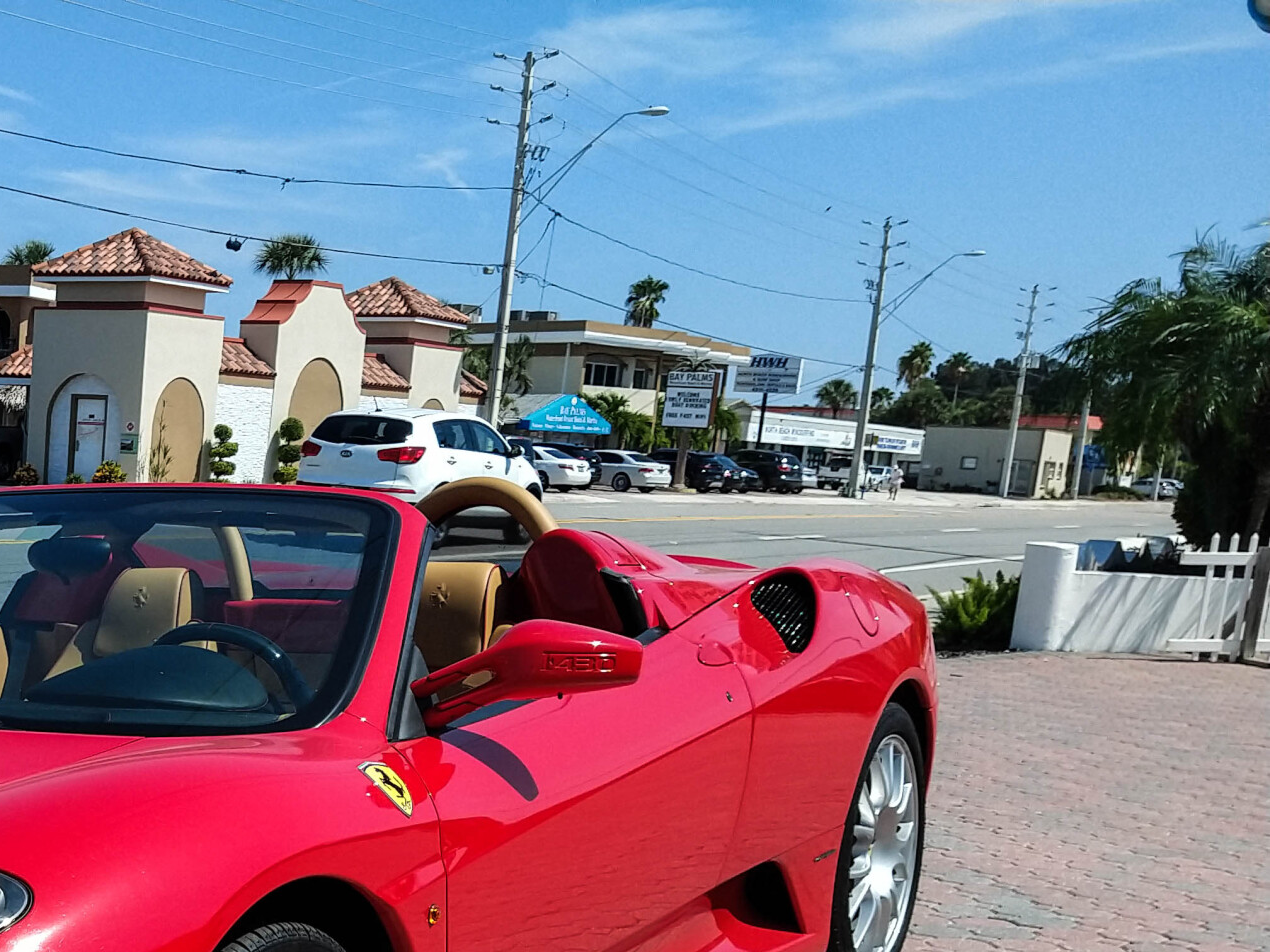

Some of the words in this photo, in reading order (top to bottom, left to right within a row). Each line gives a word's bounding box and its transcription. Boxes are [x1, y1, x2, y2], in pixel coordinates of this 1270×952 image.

[750, 357, 788, 368] HWH
[669, 373, 684, 381] BAY
[686, 373, 713, 382] PALMS
